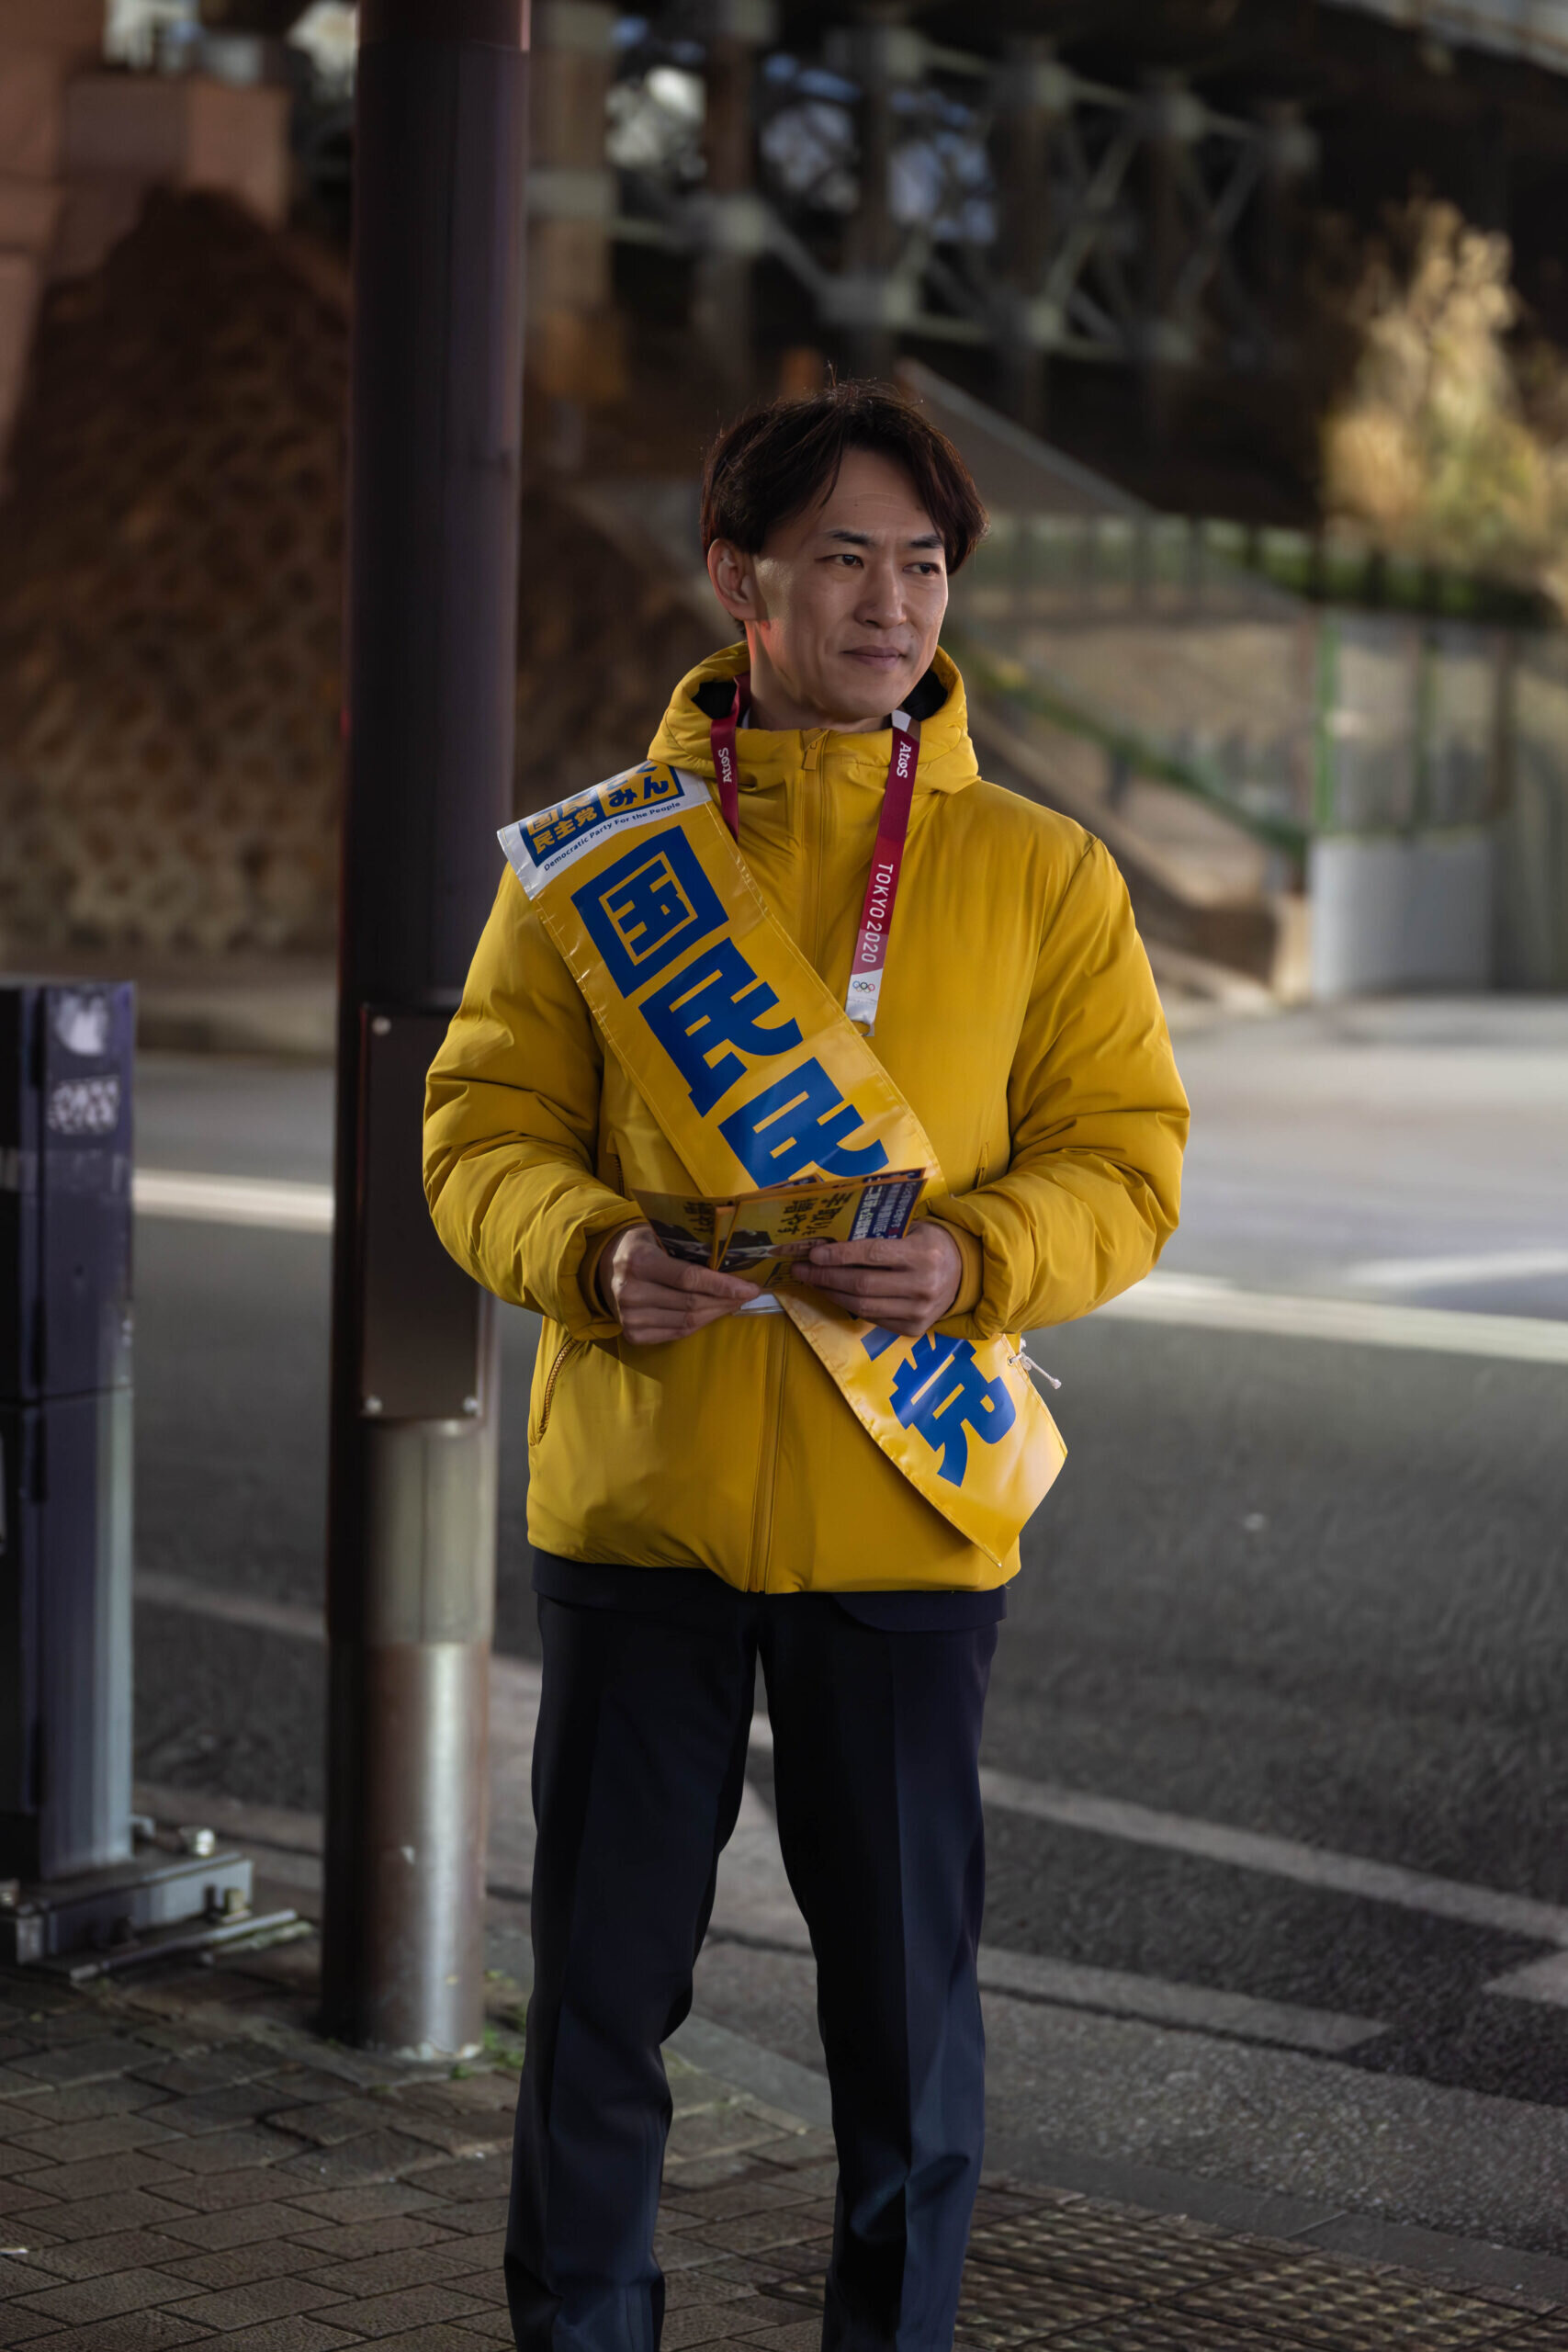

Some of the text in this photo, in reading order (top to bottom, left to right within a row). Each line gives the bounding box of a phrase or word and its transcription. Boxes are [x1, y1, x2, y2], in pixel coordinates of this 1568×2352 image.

[607, 775, 670, 808] みん
[532, 806, 598, 855] 民主党
[544, 801, 682, 872] Democratic Party For the People
[861, 863, 894, 964] TOKYO 2020
